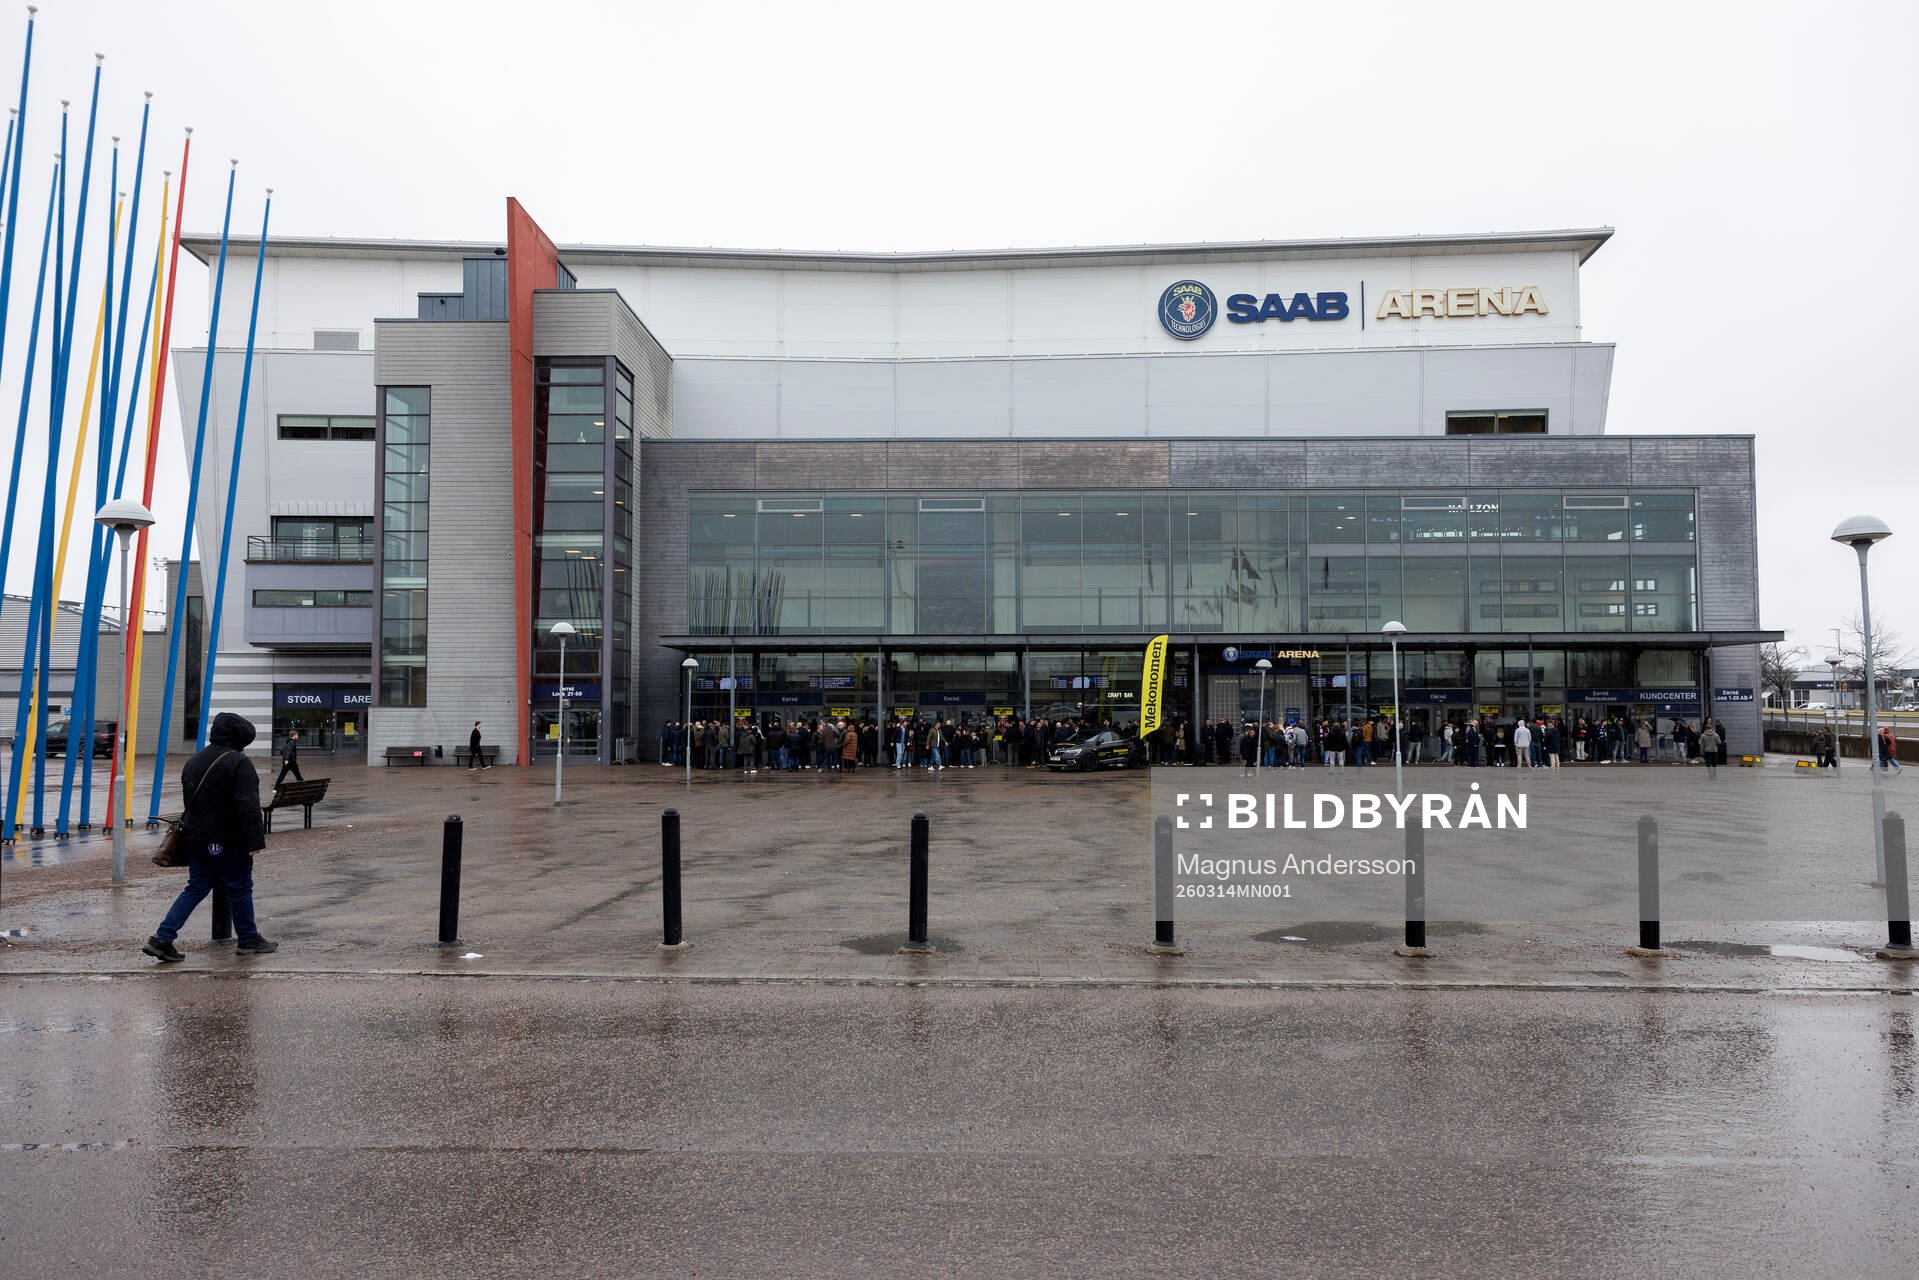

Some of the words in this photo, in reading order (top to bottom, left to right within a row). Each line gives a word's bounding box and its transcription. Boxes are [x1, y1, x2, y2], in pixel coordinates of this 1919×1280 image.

[1172, 285, 1202, 297] SAAB
[1226, 291, 1350, 324] SAAB
[1376, 285, 1549, 321] ARENA
[1171, 321, 1206, 334] TECHNOLOGIES
[1277, 650, 1320, 659] ARENA
[1145, 641, 1163, 729] Mekonomen
[287, 695, 322, 704] STORA
[1640, 692, 1697, 700] KUNDCENTER
